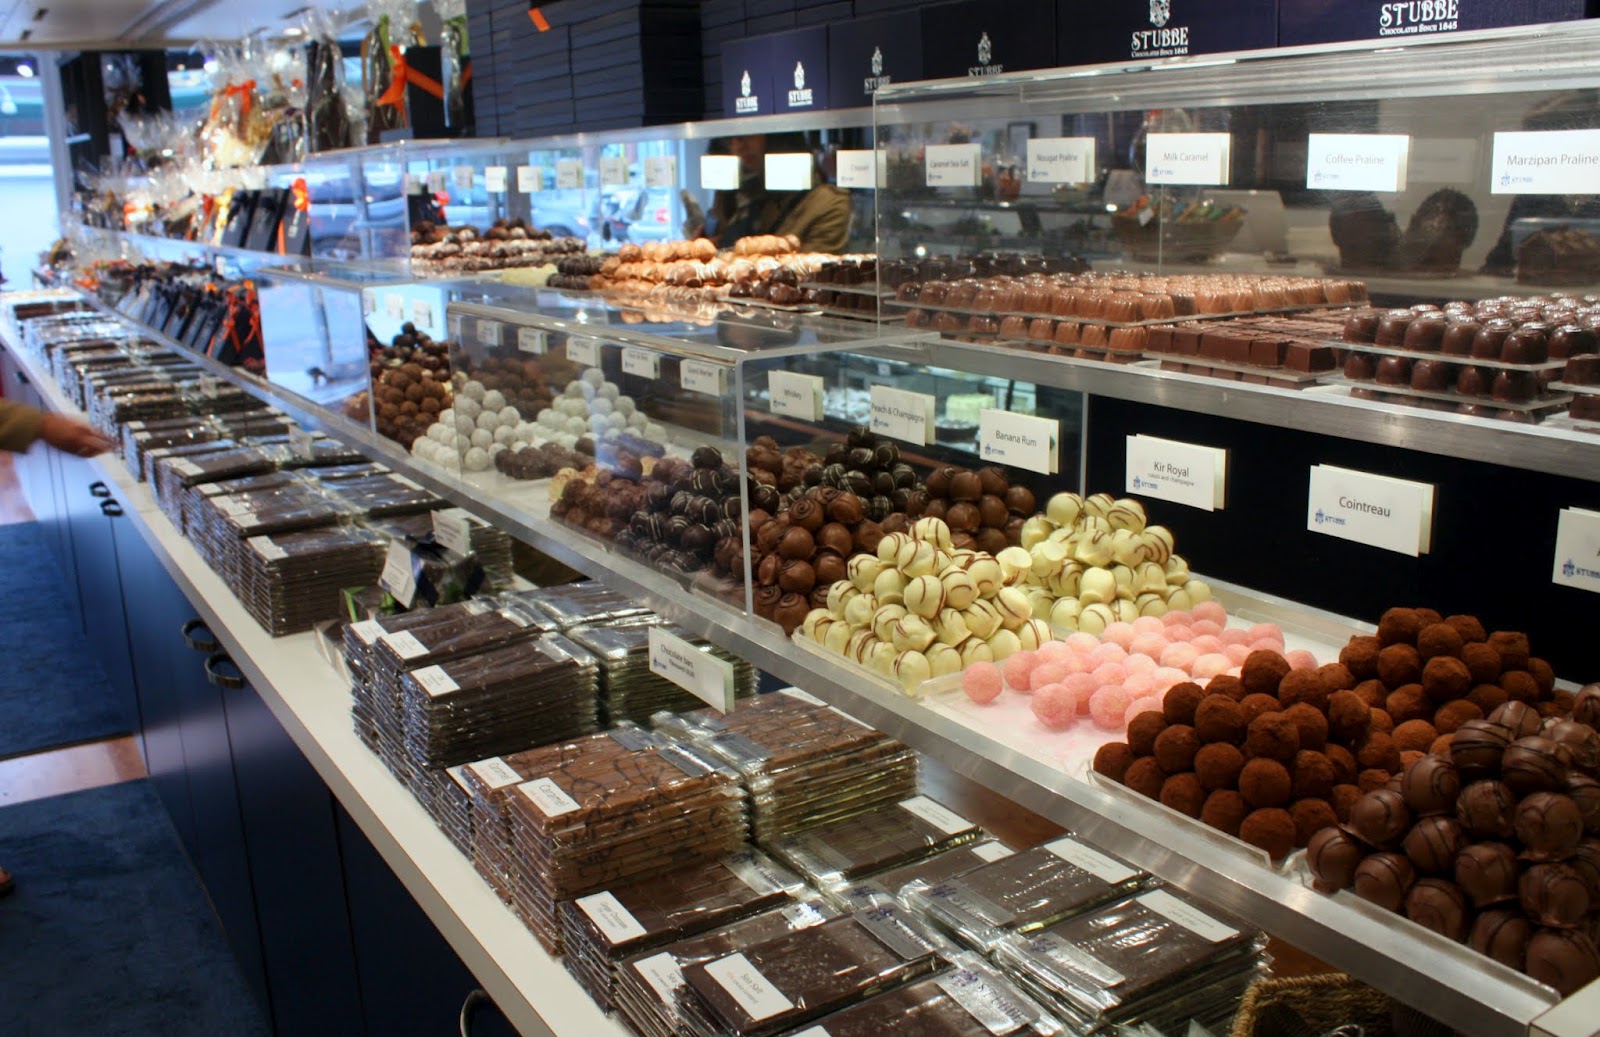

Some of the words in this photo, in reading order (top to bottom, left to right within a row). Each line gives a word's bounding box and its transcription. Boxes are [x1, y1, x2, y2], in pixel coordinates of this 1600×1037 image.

[1380, 0, 1459, 27] STUBBE
[1439, 21, 1458, 31] 1845
[1131, 27, 1189, 51] STUBBE
[1036, 153, 1058, 163] Nougat
[1163, 151, 1178, 162] Milk
[1179, 152, 1209, 162] Caramel
[1325, 154, 1354, 165] Coffee
[1355, 154, 1385, 165] Praline
[1506, 154, 1558, 167] Marzipan
[1560, 153, 1599, 165] Praline
[871, 402, 888, 415] Peach
[893, 407, 925, 424] Champagne
[995, 430, 1020, 444] Banana
[1021, 435, 1037, 447] Rum
[1153, 461, 1166, 472] Kir
[1166, 463, 1190, 478] Royal
[1338, 496, 1391, 518] Cointreau
[488, 761, 514, 781] Caramel
[538, 783, 569, 807] Caramel
